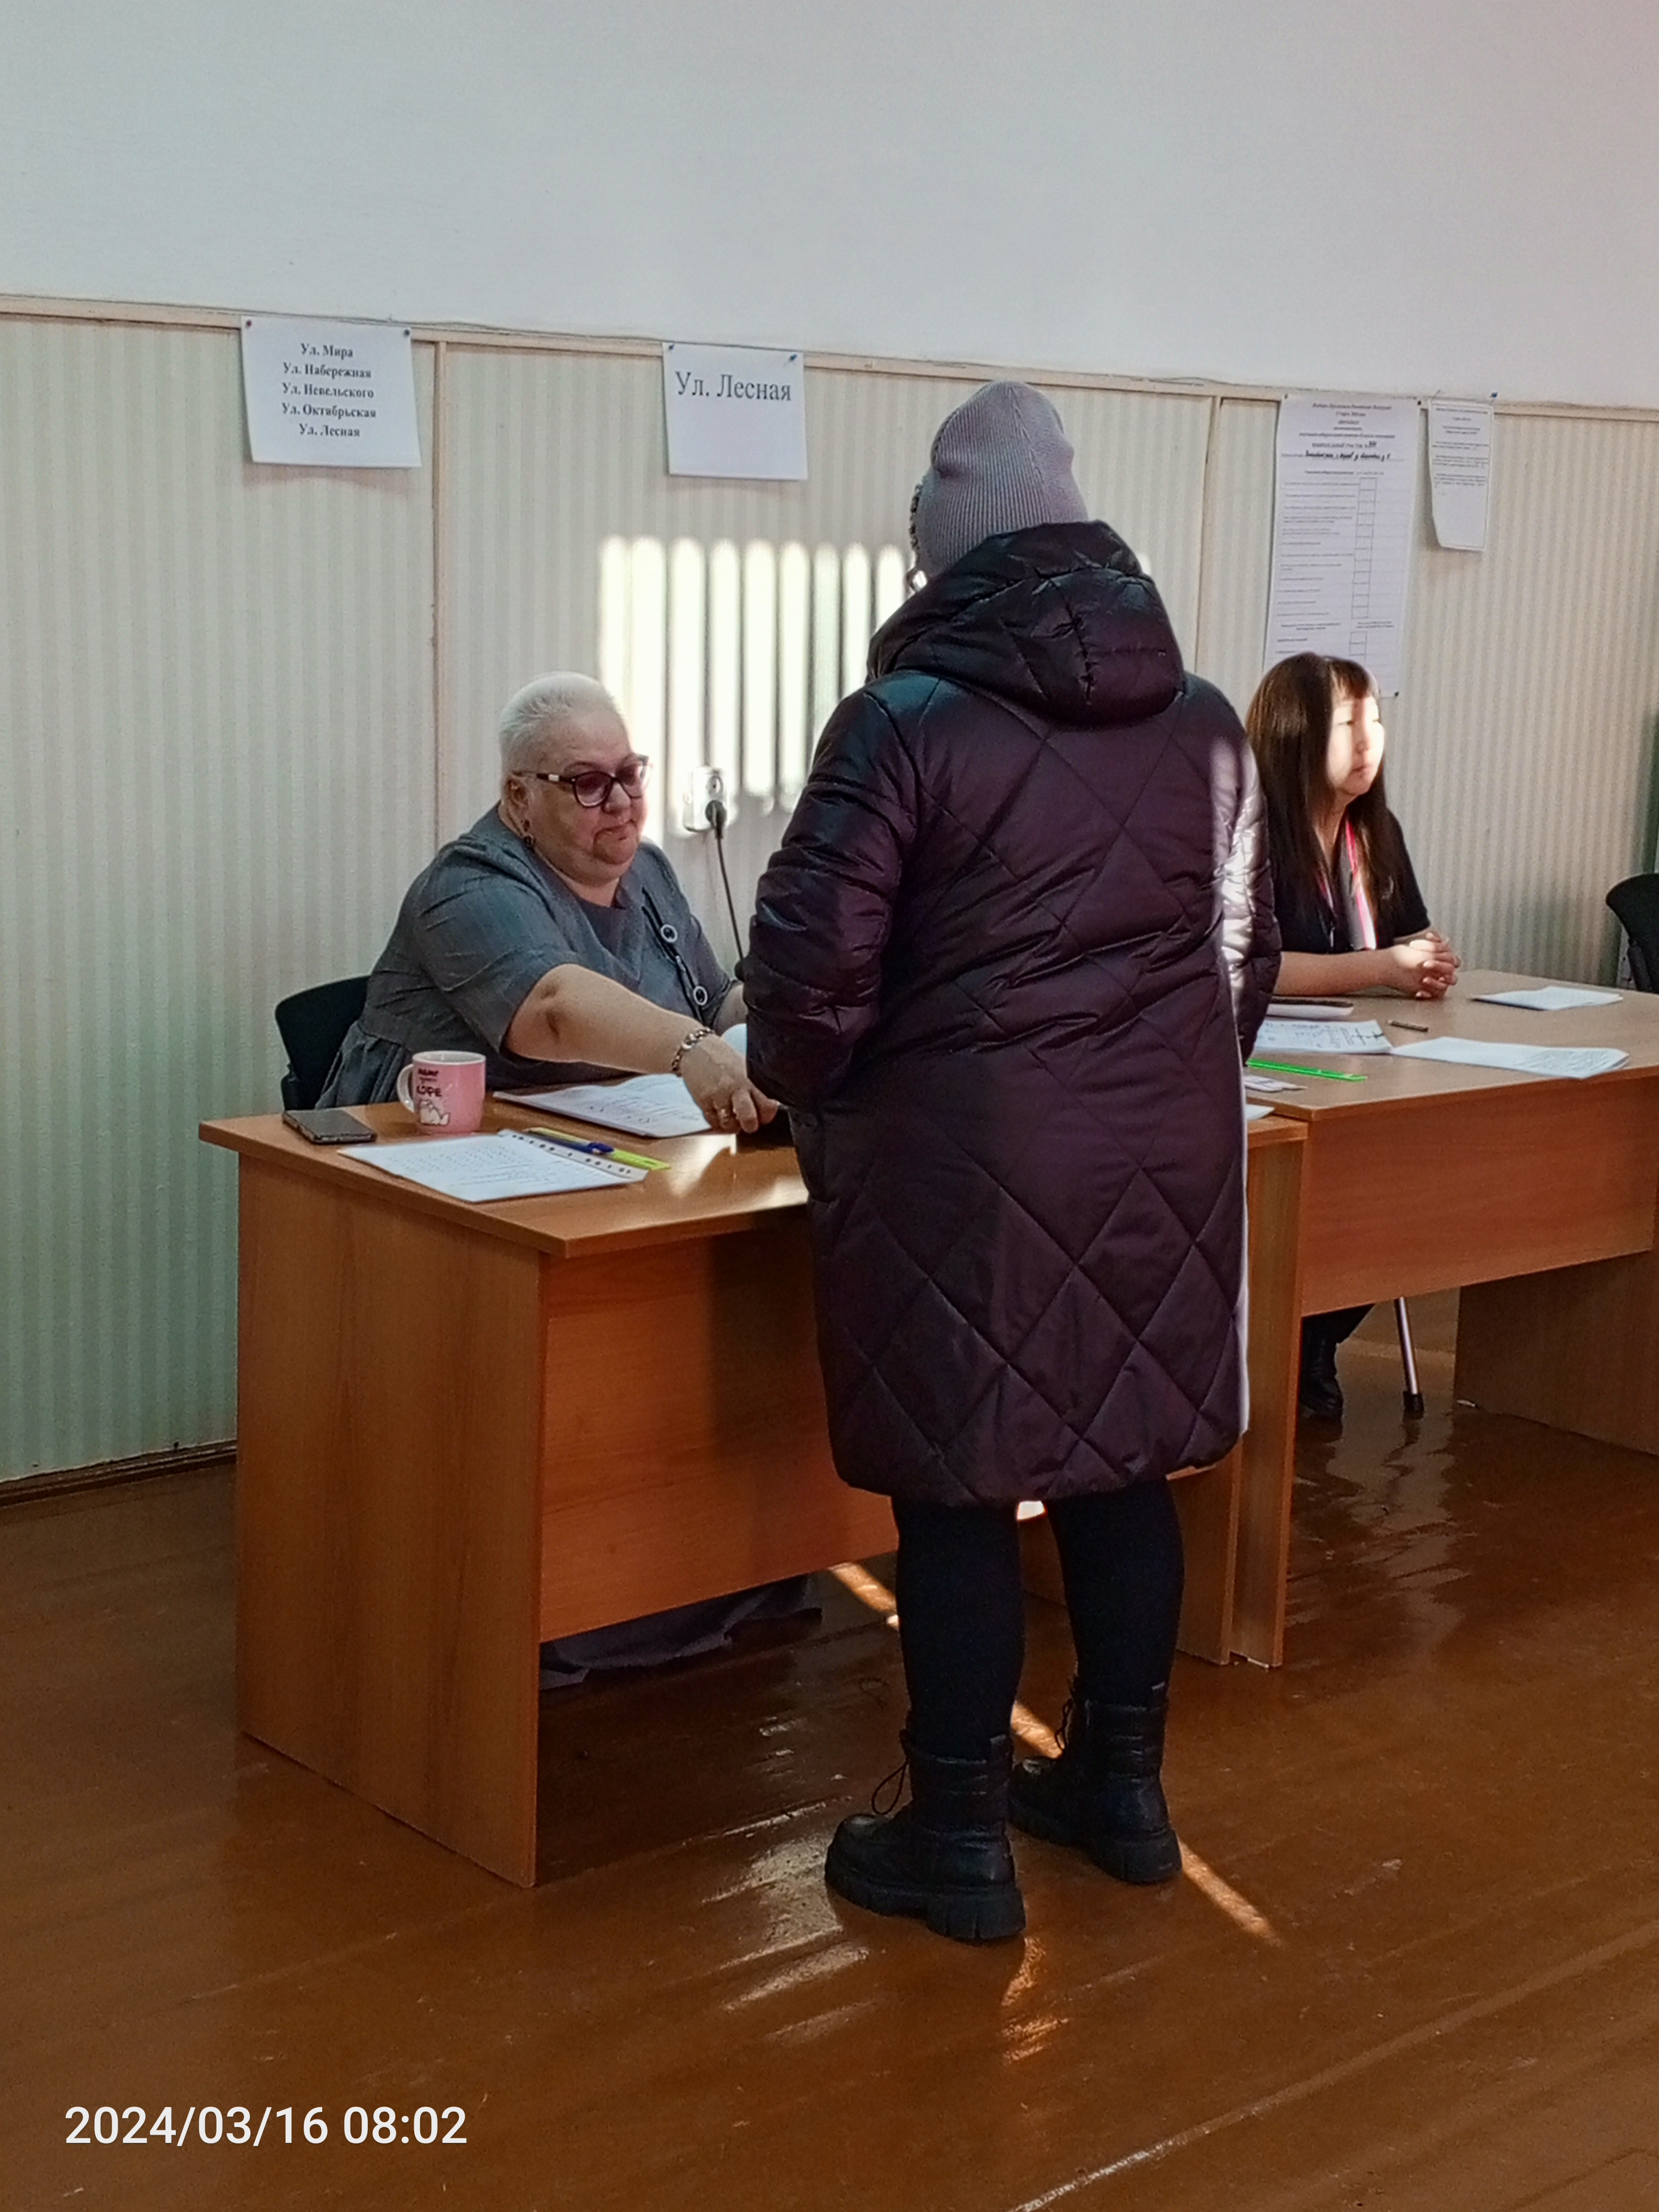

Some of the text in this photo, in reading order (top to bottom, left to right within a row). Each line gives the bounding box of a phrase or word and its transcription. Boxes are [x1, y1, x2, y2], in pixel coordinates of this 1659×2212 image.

[301, 342, 353, 360] Ул. Мира
[283, 362, 371, 379] Ул. Набережная
[282, 382, 374, 398] Ул. Невельского
[675, 371, 792, 401] Ул. Лесная
[282, 402, 376, 419] Ул. Октябрьская
[299, 423, 360, 437] Ул. Лесная
